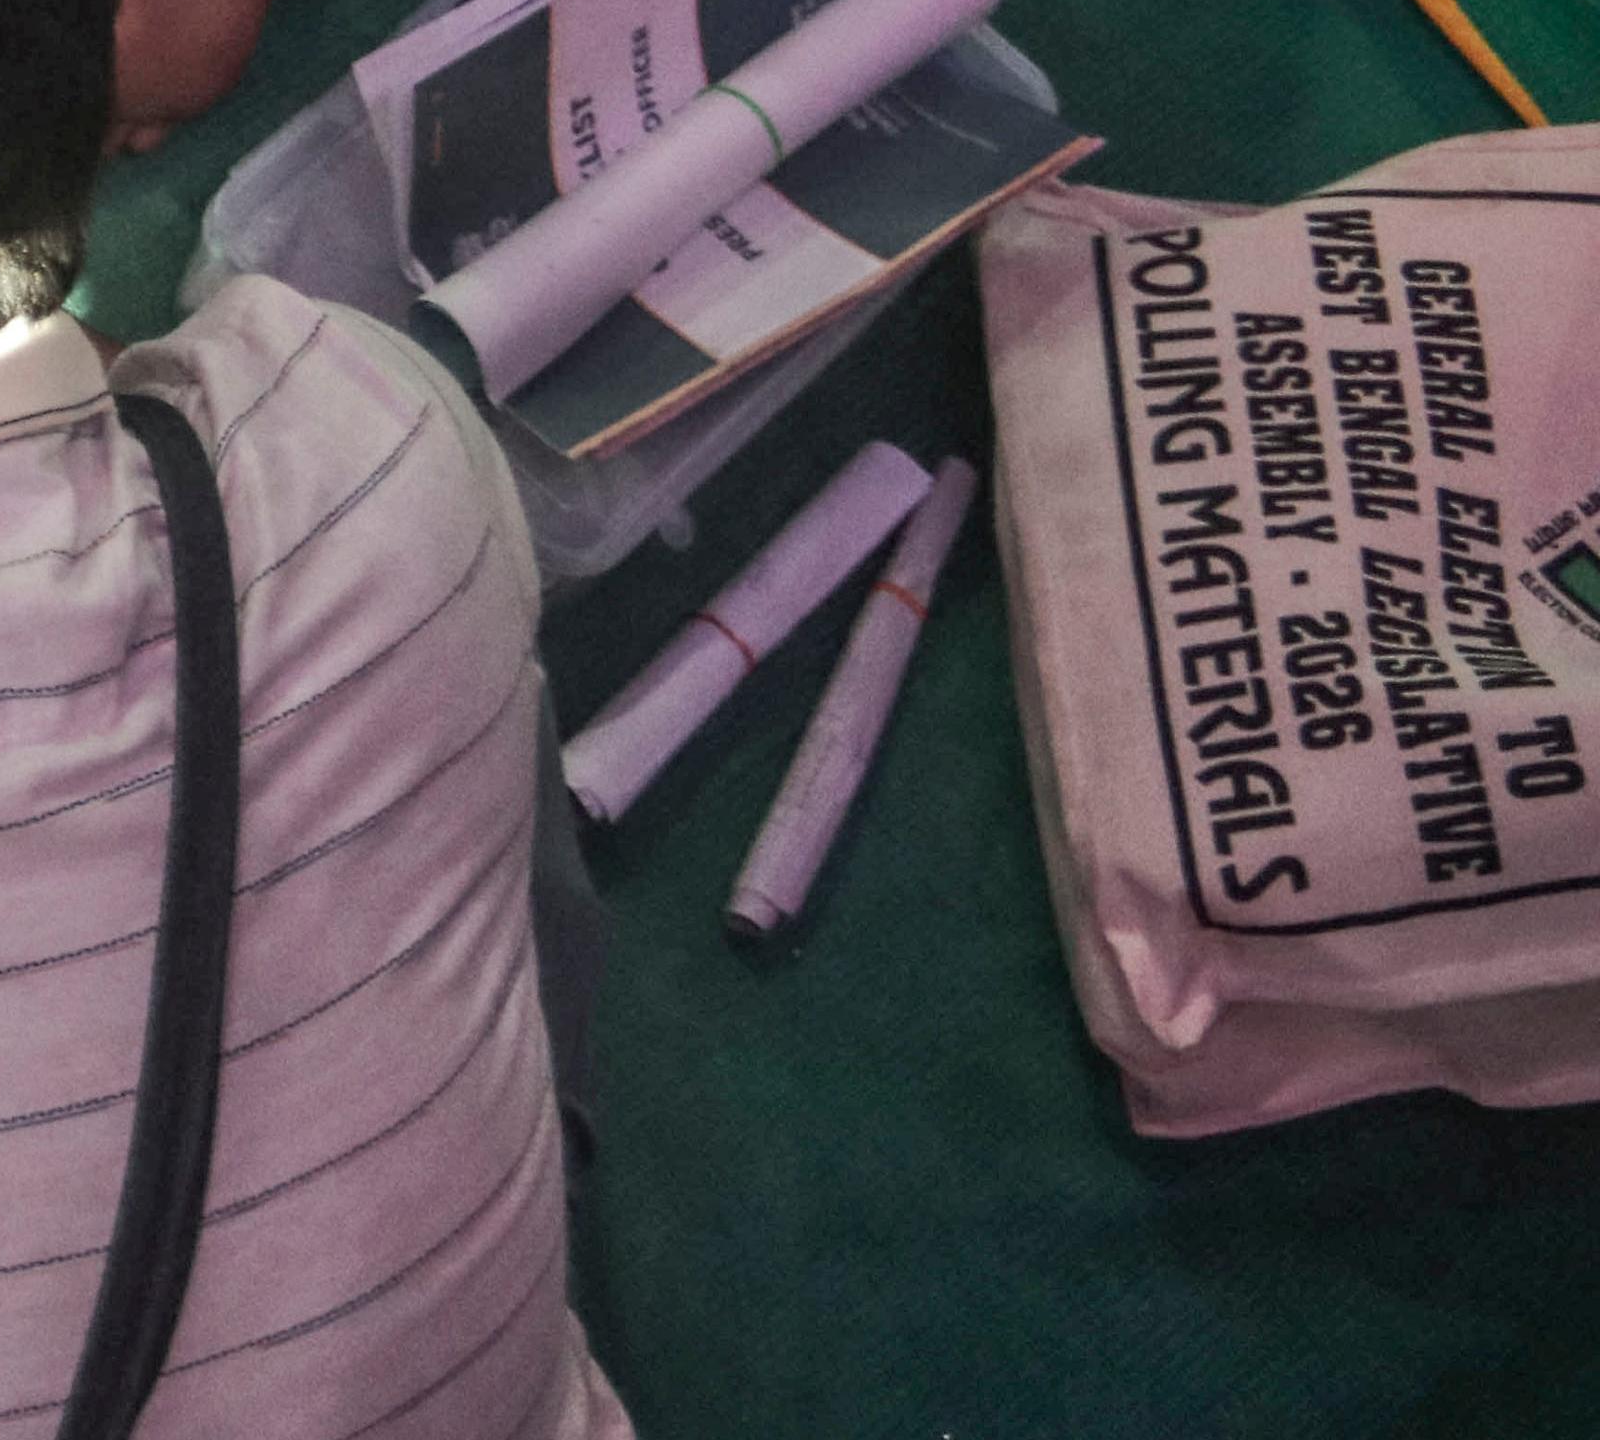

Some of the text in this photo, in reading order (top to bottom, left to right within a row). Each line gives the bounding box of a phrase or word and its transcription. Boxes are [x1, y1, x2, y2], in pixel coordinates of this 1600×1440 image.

[1128, 228, 1309, 902] POLLING MATERIALS
[1235, 313, 1338, 542] ASSEMBLY
[1280, 612, 1372, 750] 2026
[1308, 210, 1501, 882] WEST BENGAL LEGISLATIVE
[1402, 260, 1495, 460] GENERAL
[1498, 715, 1585, 798] TO
